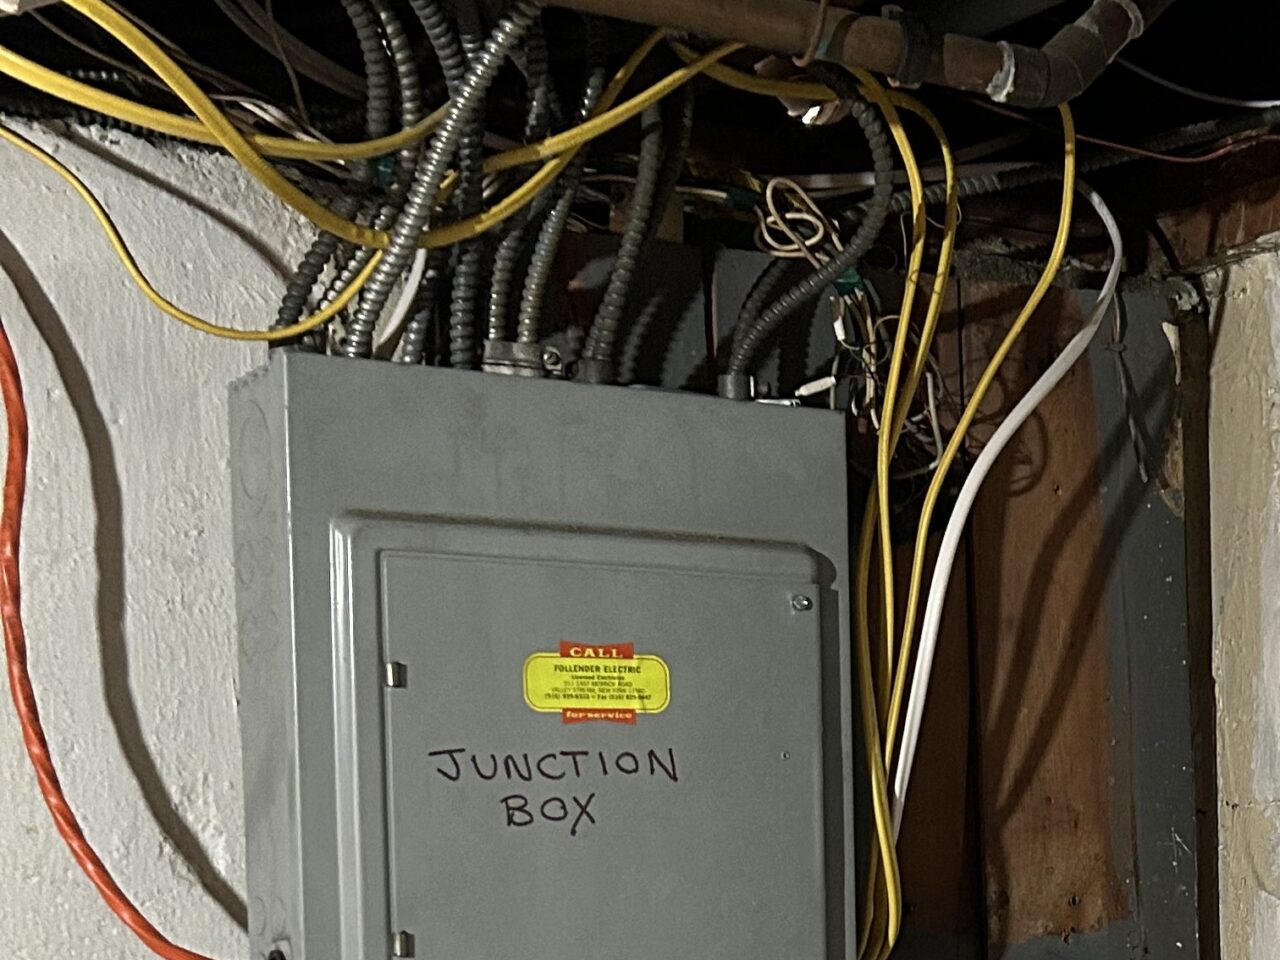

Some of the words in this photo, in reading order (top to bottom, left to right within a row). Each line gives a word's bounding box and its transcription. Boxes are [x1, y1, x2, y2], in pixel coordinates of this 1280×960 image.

[570, 646, 624, 658] CALL
[554, 664, 601, 673] FOLLENDER
[603, 665, 641, 674] ELECTRIC
[587, 711, 633, 719] service
[428, 748, 679, 783] JUNCTION
[500, 793, 596, 836] BOX
